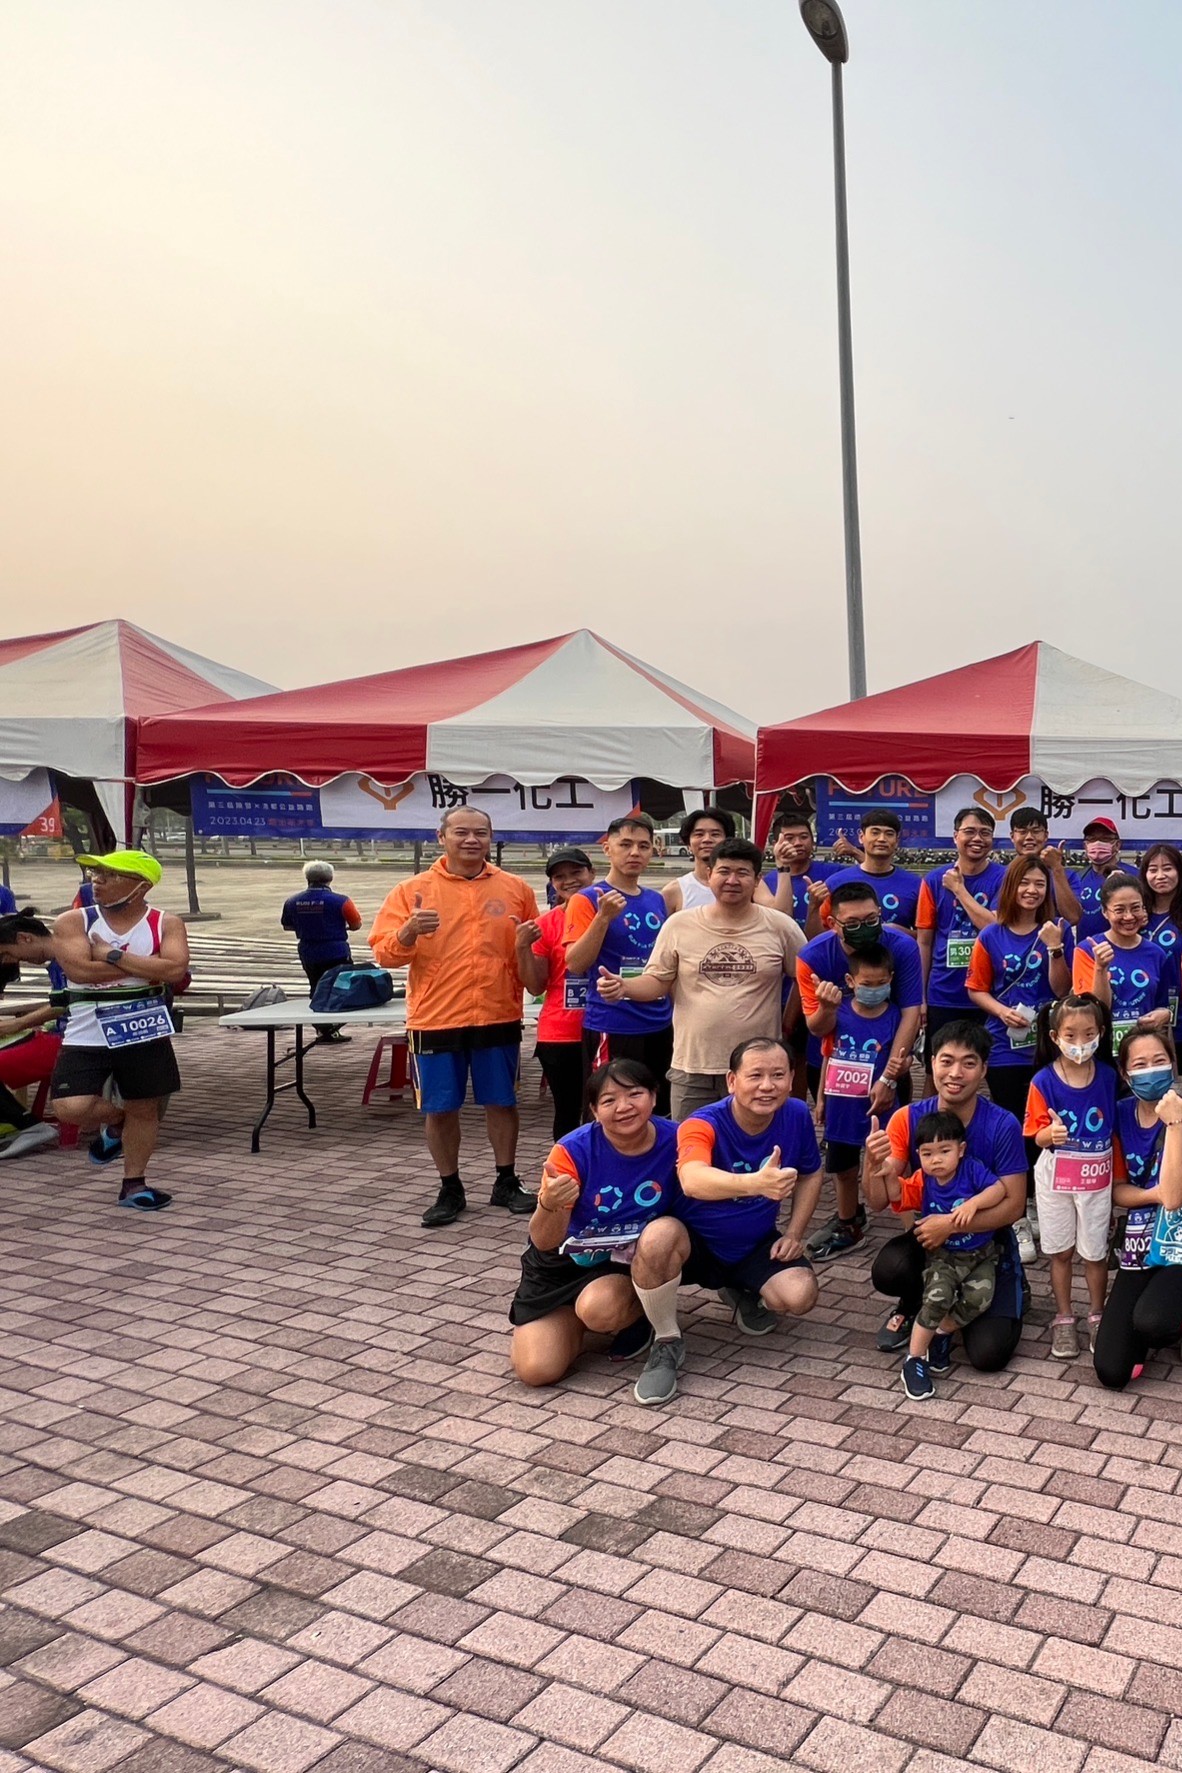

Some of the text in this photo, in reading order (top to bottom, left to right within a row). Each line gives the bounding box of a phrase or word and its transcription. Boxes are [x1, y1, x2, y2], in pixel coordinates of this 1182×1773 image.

[428, 775, 594, 810] 勝一化工
[38, 816, 55, 833] 39
[567, 988, 575, 997] B
[106, 1014, 166, 1037] A 10026
[836, 1069, 869, 1085] 7002
[1124, 1235, 1153, 1252] 8002
